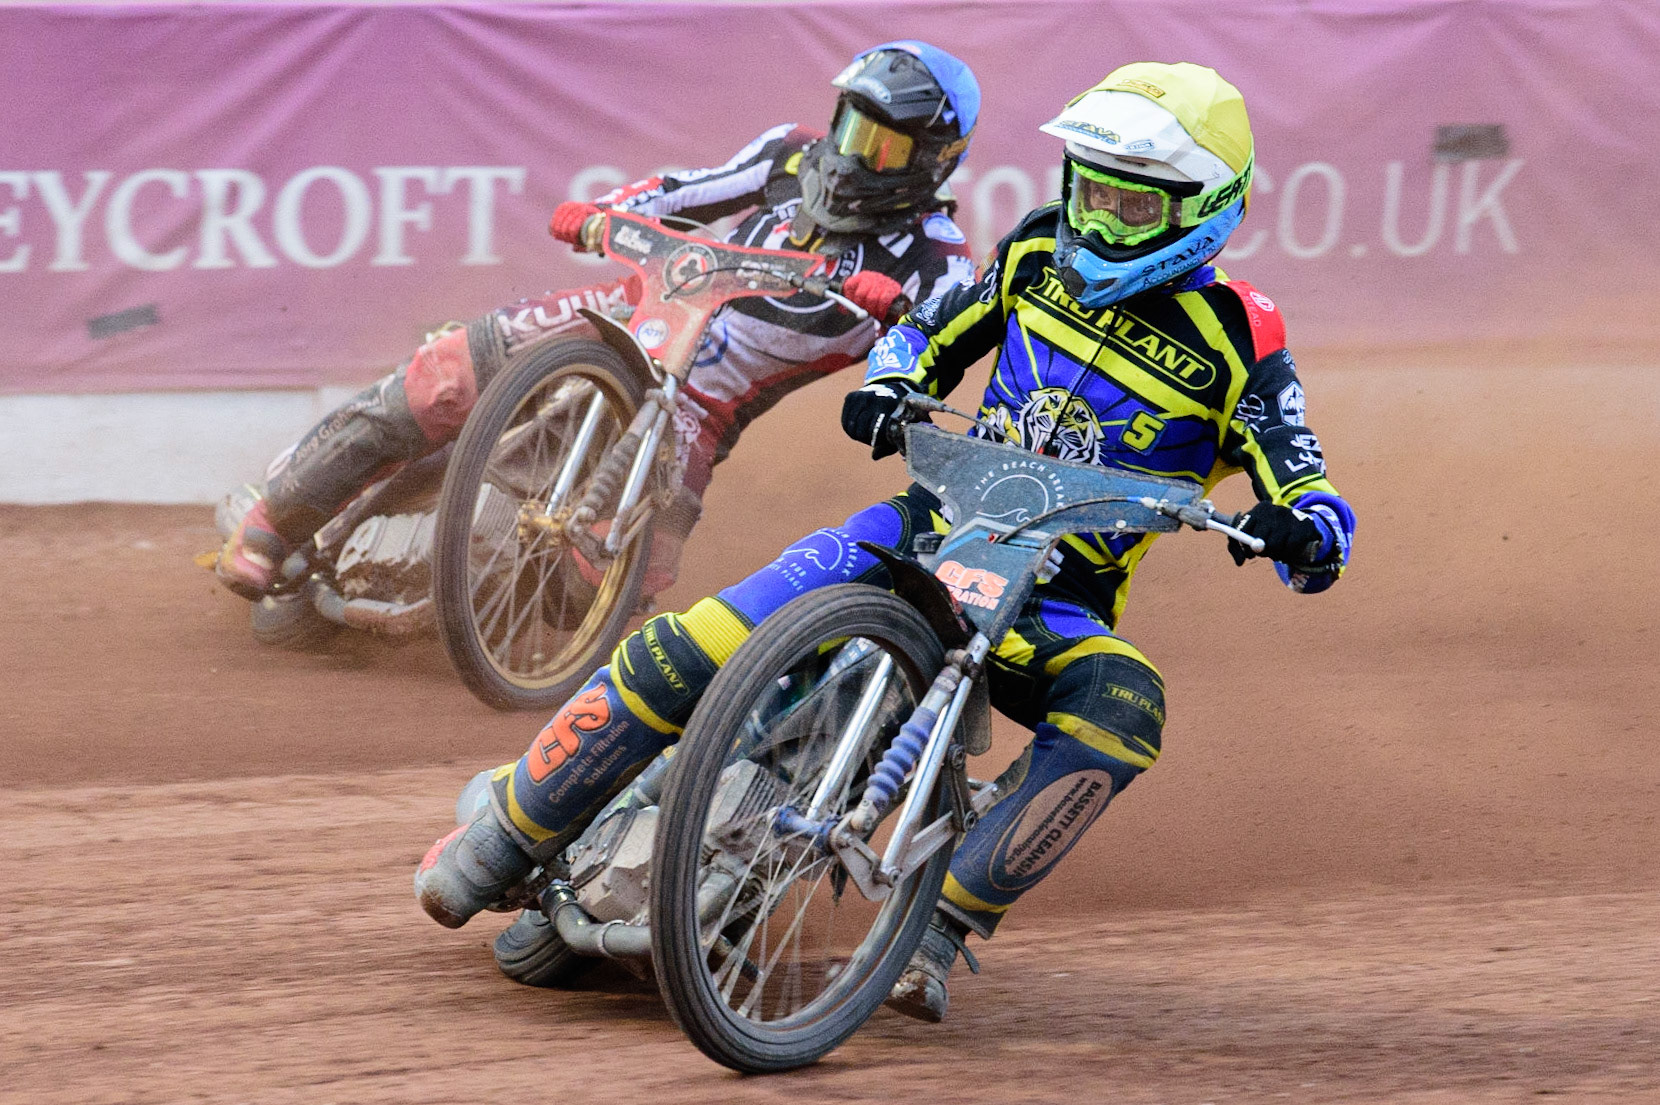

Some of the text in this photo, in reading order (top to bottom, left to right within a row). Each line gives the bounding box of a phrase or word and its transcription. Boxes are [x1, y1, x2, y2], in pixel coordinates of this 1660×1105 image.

[1141, 236, 1215, 277] STAVA
[1095, 307, 1206, 380] PLANT
[974, 460, 1065, 508] THE BEACH BREAK
[651, 647, 685, 689] PLANT
[1110, 686, 1140, 704] TRU
[549, 752, 595, 804] Complete
[582, 744, 628, 788] Solutions
[1059, 779, 1102, 831] BASSETT
